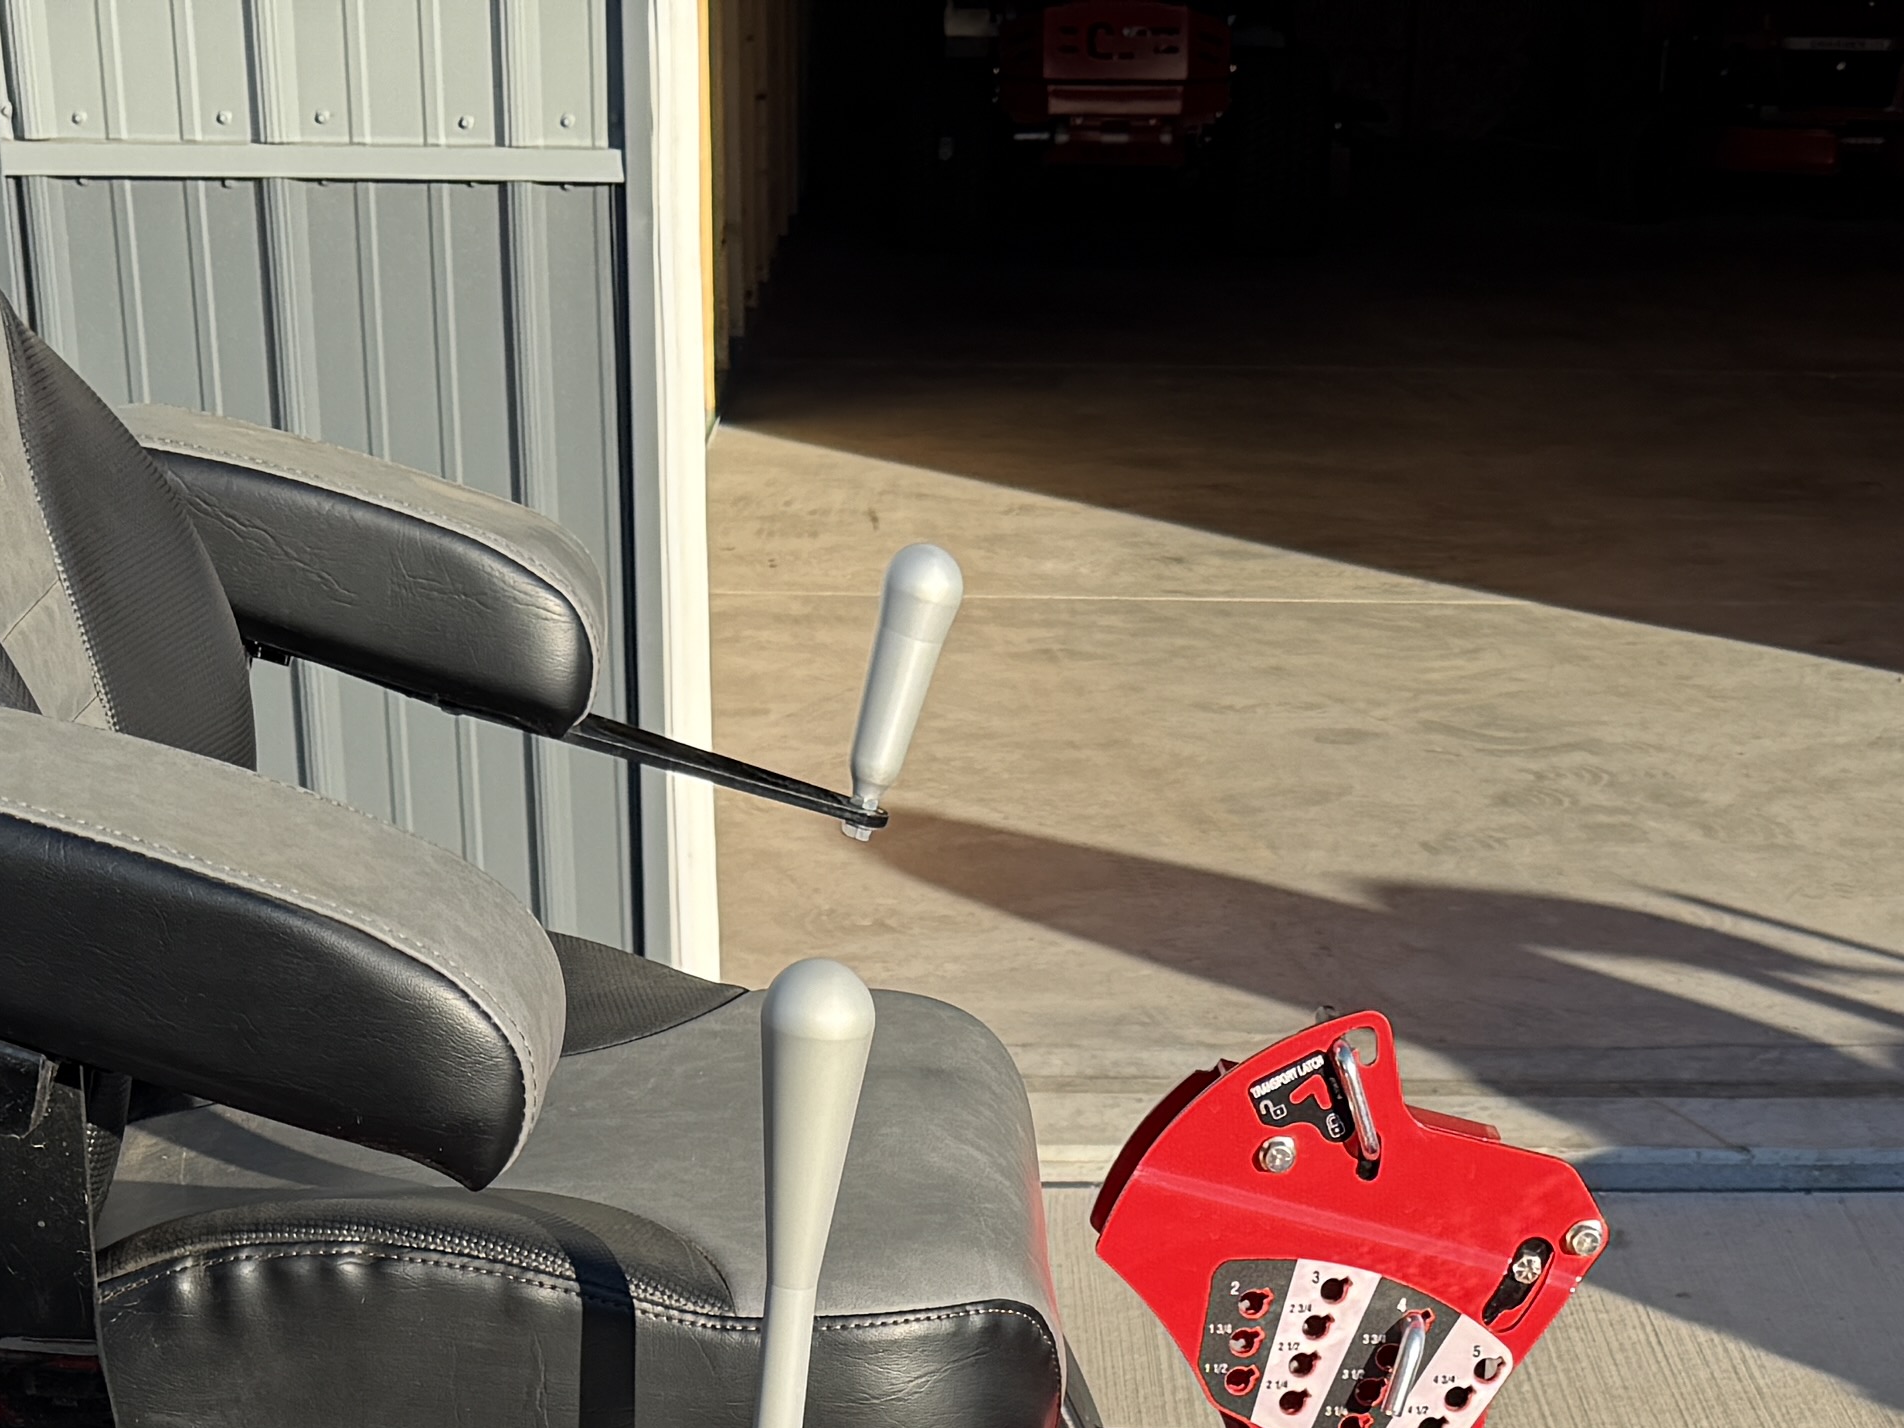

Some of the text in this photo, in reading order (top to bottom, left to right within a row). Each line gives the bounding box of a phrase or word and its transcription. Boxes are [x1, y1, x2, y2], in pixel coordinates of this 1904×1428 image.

[1250, 1067, 1298, 1099] TRANSPORT
[1296, 1055, 1325, 1077] LATCH
[1312, 1270, 1320, 1284] 3
[1230, 1281, 1240, 1296] 2
[1289, 1303, 1312, 1313] 2 3/4
[1397, 1297, 1407, 1312] 4
[1209, 1323, 1232, 1335] 1 3/4
[1362, 1334, 1369, 1344] 3
[1278, 1342, 1300, 1352] 2 1/2
[1472, 1345, 1481, 1358] 5
[1215, 1363, 1229, 1374] 1/2
[1341, 1369, 1349, 1379] 3
[1266, 1380, 1288, 1389] 2 1/4
[1433, 1375, 1455, 1384] 4 3/4
[1324, 1406, 1332, 1416] 3
[1408, 1406, 1430, 1414] 4 1/2
